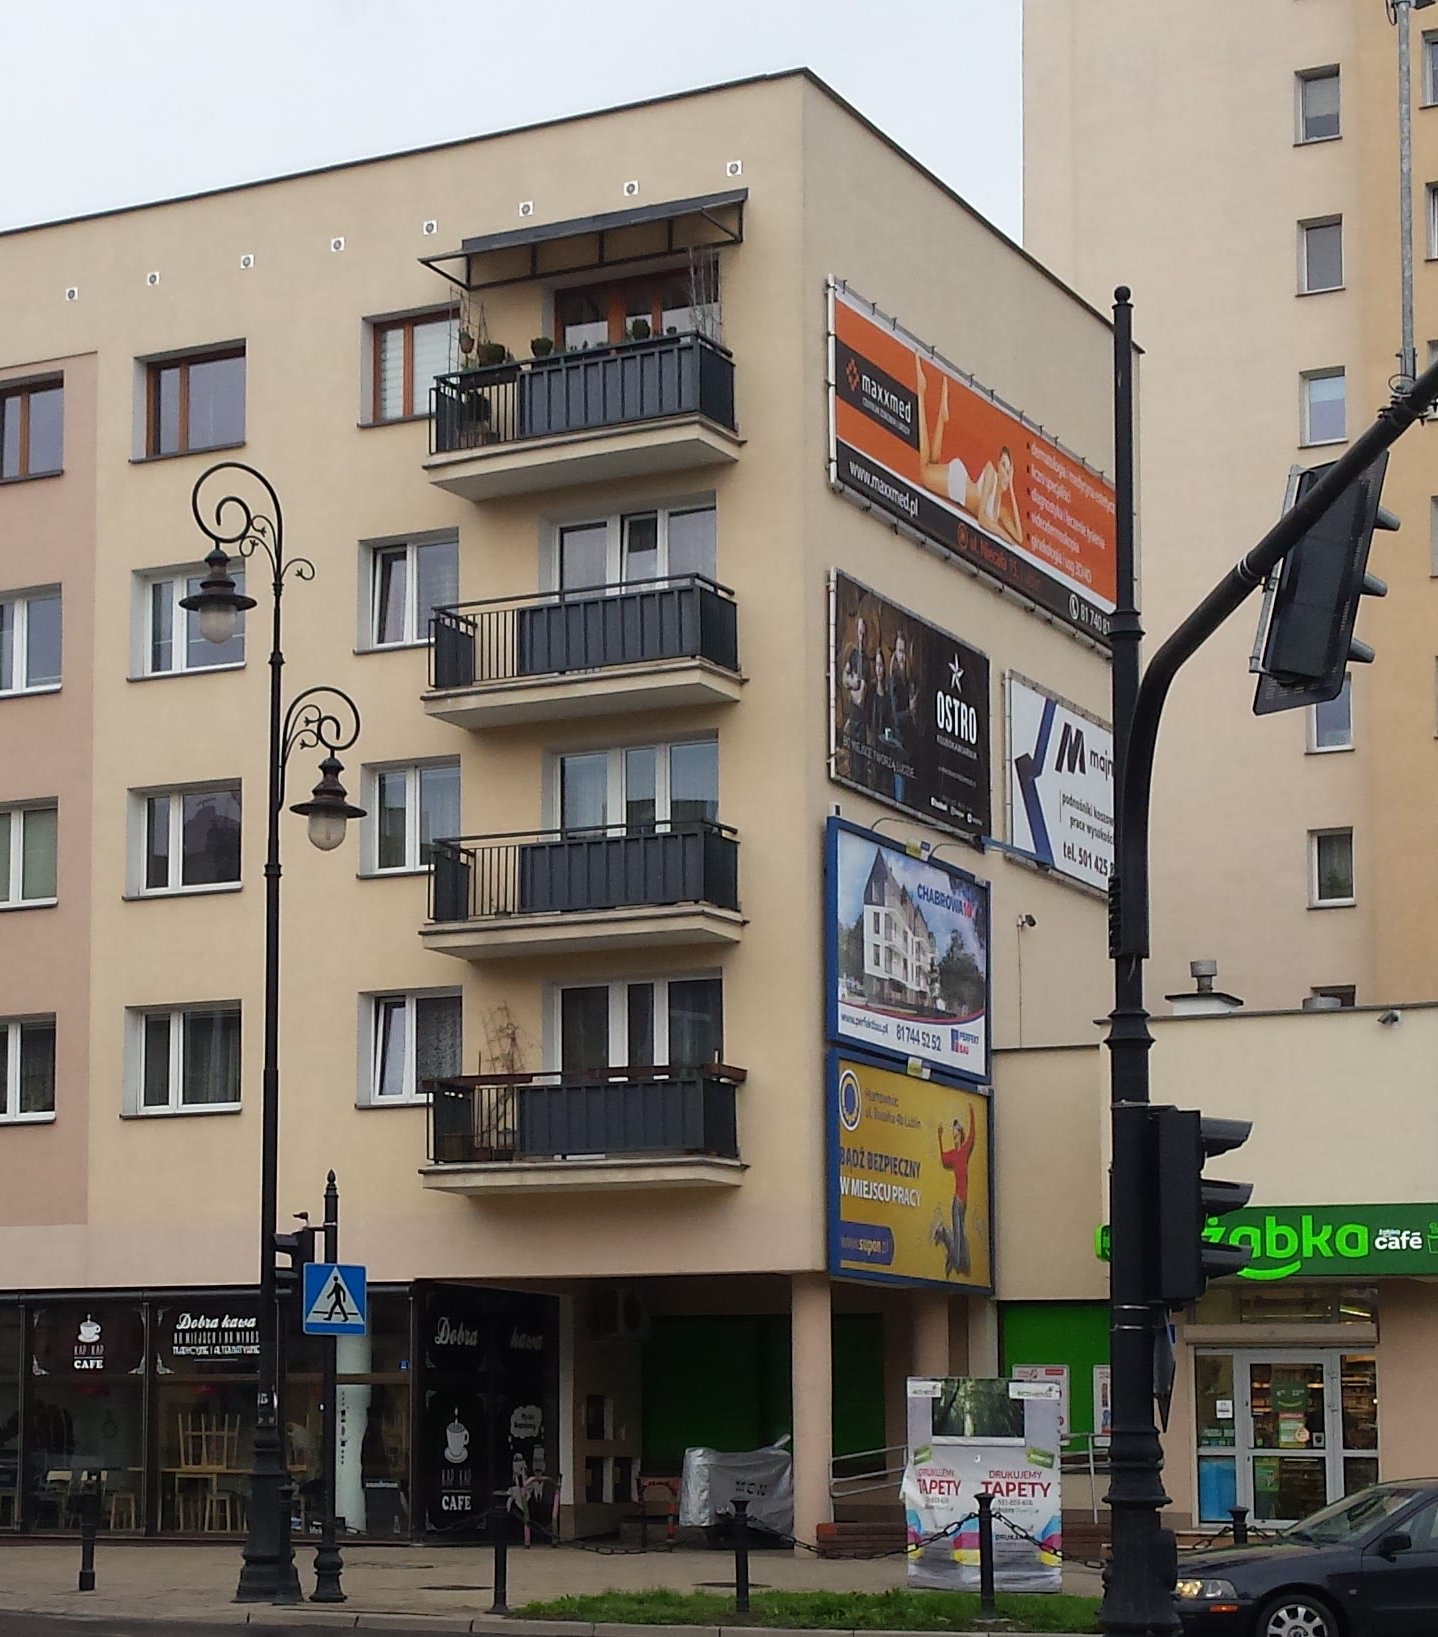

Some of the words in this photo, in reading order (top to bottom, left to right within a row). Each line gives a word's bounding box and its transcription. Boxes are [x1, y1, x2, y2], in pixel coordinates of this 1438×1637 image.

[862, 374, 912, 423] maxxmed
[849, 461, 919, 518] www.maxxmed.pl
[936, 690, 977, 744] OSTRO
[1063, 841, 1076, 864] tel.
[1078, 847, 1092, 870] 501
[1094, 855, 1108, 877] 425
[896, 1024, 905, 1041] 81
[905, 1027, 920, 1045] 744
[921, 1031, 931, 1049] 52
[931, 1034, 941, 1051] 52
[867, 1151, 921, 1179] BEZPIECZNY
[839, 1175, 850, 1196] W
[850, 1178, 891, 1202] MIEJSCU
[892, 1185, 921, 1208] PRACY
[1201, 1214, 1369, 1260] żabka
[175, 1312, 219, 1329] Dobra
[221, 1313, 257, 1329] kawa
[434, 1316, 478, 1347] Dobra
[73, 1360, 104, 1369] CAFE
[917, 1478, 962, 1497] TAPETY
[989, 1470, 1042, 1479] DRUKUJEMY
[441, 1495, 472, 1511] CAFE
[981, 1481, 1052, 1498] TAPETY
